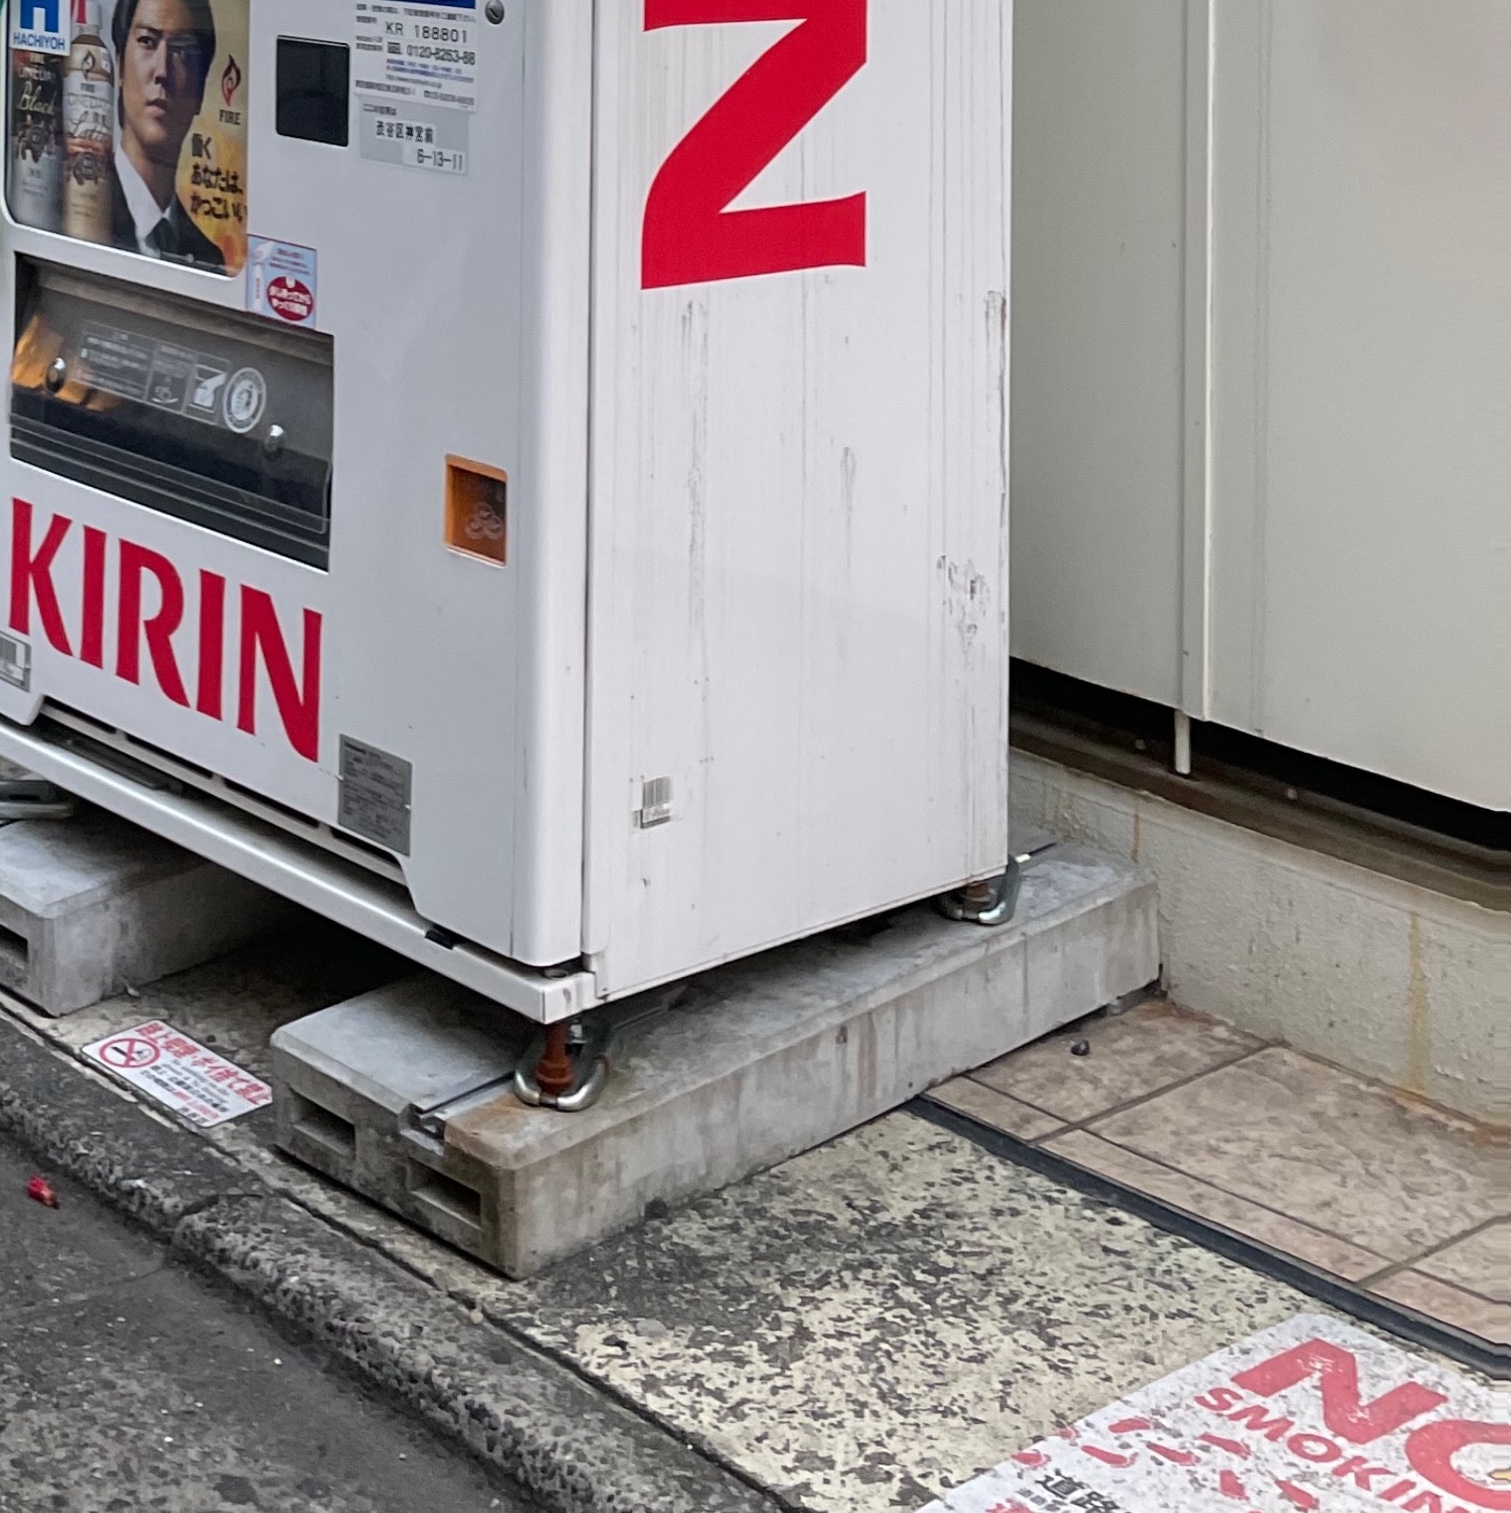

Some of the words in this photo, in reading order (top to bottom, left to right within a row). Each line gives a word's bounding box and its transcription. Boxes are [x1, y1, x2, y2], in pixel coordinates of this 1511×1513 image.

[13, 31, 66, 51] HACHIYOH
[219, 108, 241, 125] FIRE
[8, 496, 323, 763] KIRIN
